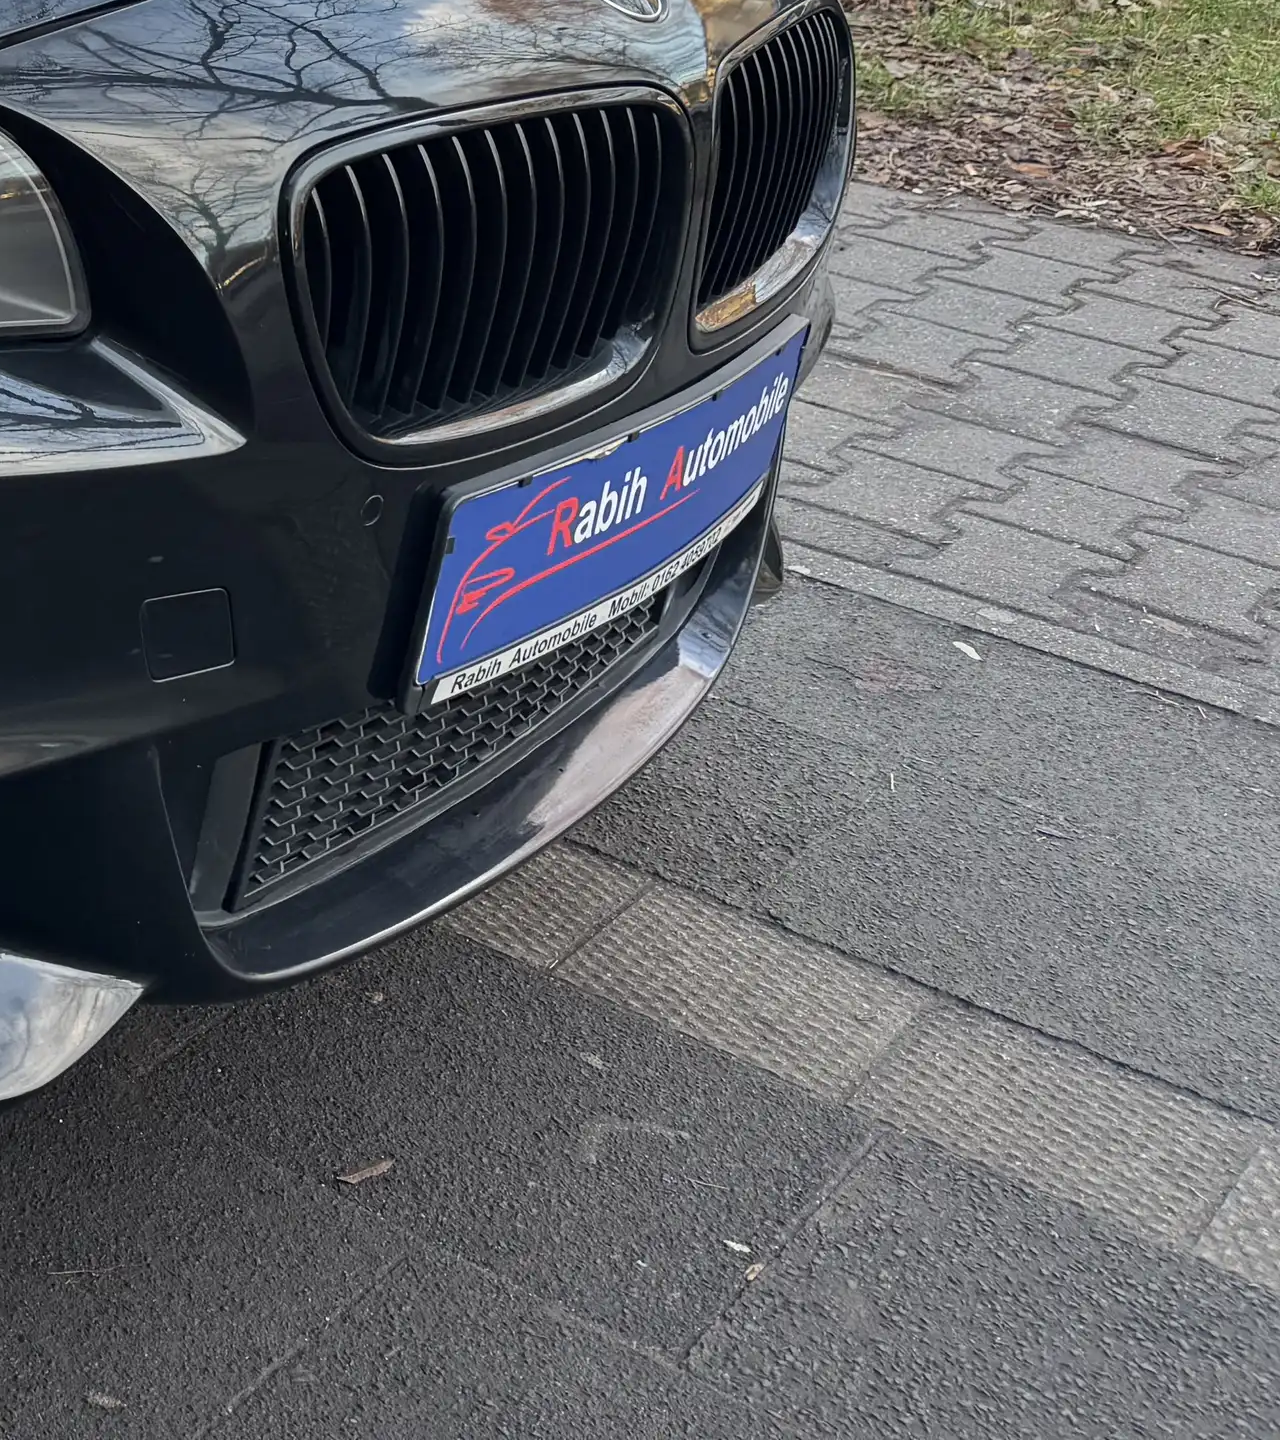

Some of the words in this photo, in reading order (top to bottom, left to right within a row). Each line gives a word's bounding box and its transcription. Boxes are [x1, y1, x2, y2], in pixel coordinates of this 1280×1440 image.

[546, 467, 648, 556] Rabih
[659, 371, 790, 501] Automobile
[450, 660, 502, 694] Rabih
[509, 612, 598, 666] Automobile
[608, 583, 650, 618] Mobil:
[651, 561, 679, 592] 0162
